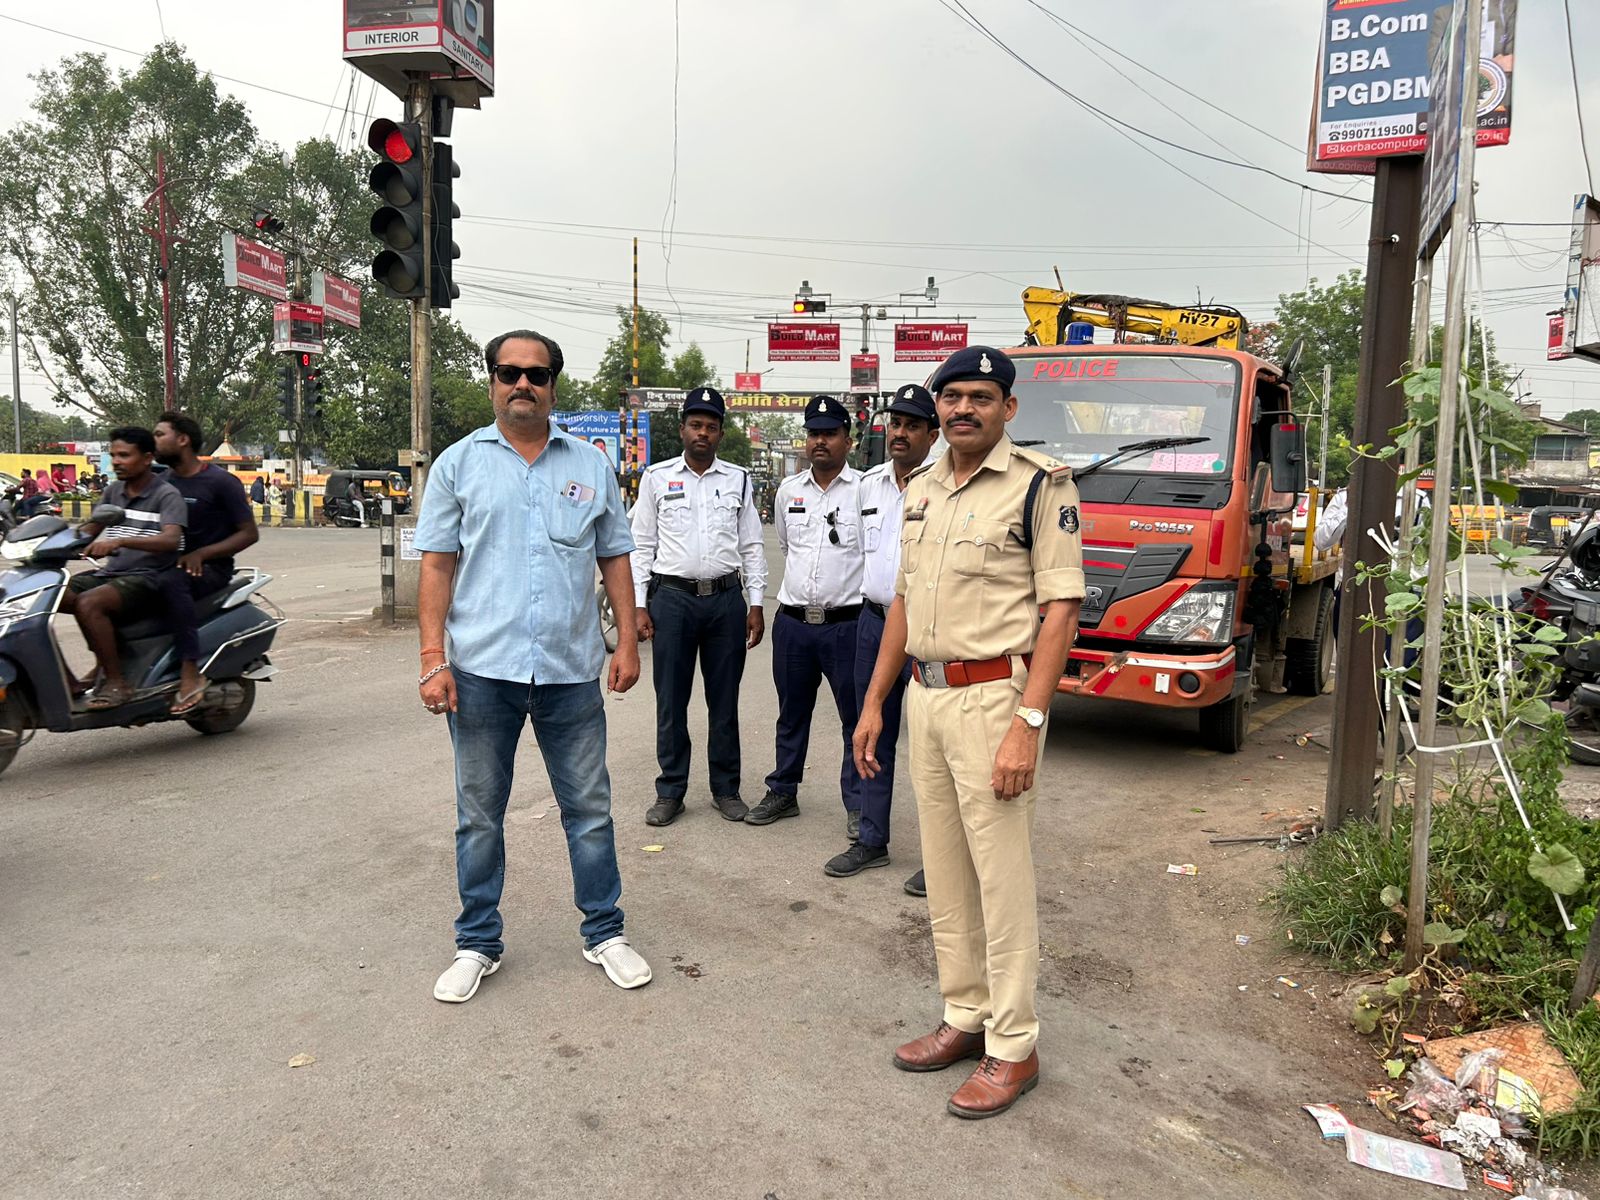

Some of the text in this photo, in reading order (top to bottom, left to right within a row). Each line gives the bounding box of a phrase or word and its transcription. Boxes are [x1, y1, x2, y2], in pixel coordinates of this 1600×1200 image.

[1331, 13, 1427, 41] B.Com
[365, 31, 419, 44] INTERIOR
[452, 41, 484, 72] SANITARY
[1329, 47, 1391, 74] BBA
[1341, 124, 1413, 140] 9907119500
[261, 254, 283, 275] MART
[1179, 312, 1220, 327] HV27
[804, 330, 836, 340] MART
[931, 330, 964, 342] MART
[1032, 359, 1119, 379] POLICE
[731, 394, 811, 407] क्रांति सेना
[563, 413, 609, 424] University
[1129, 520, 1153, 532] Pro
